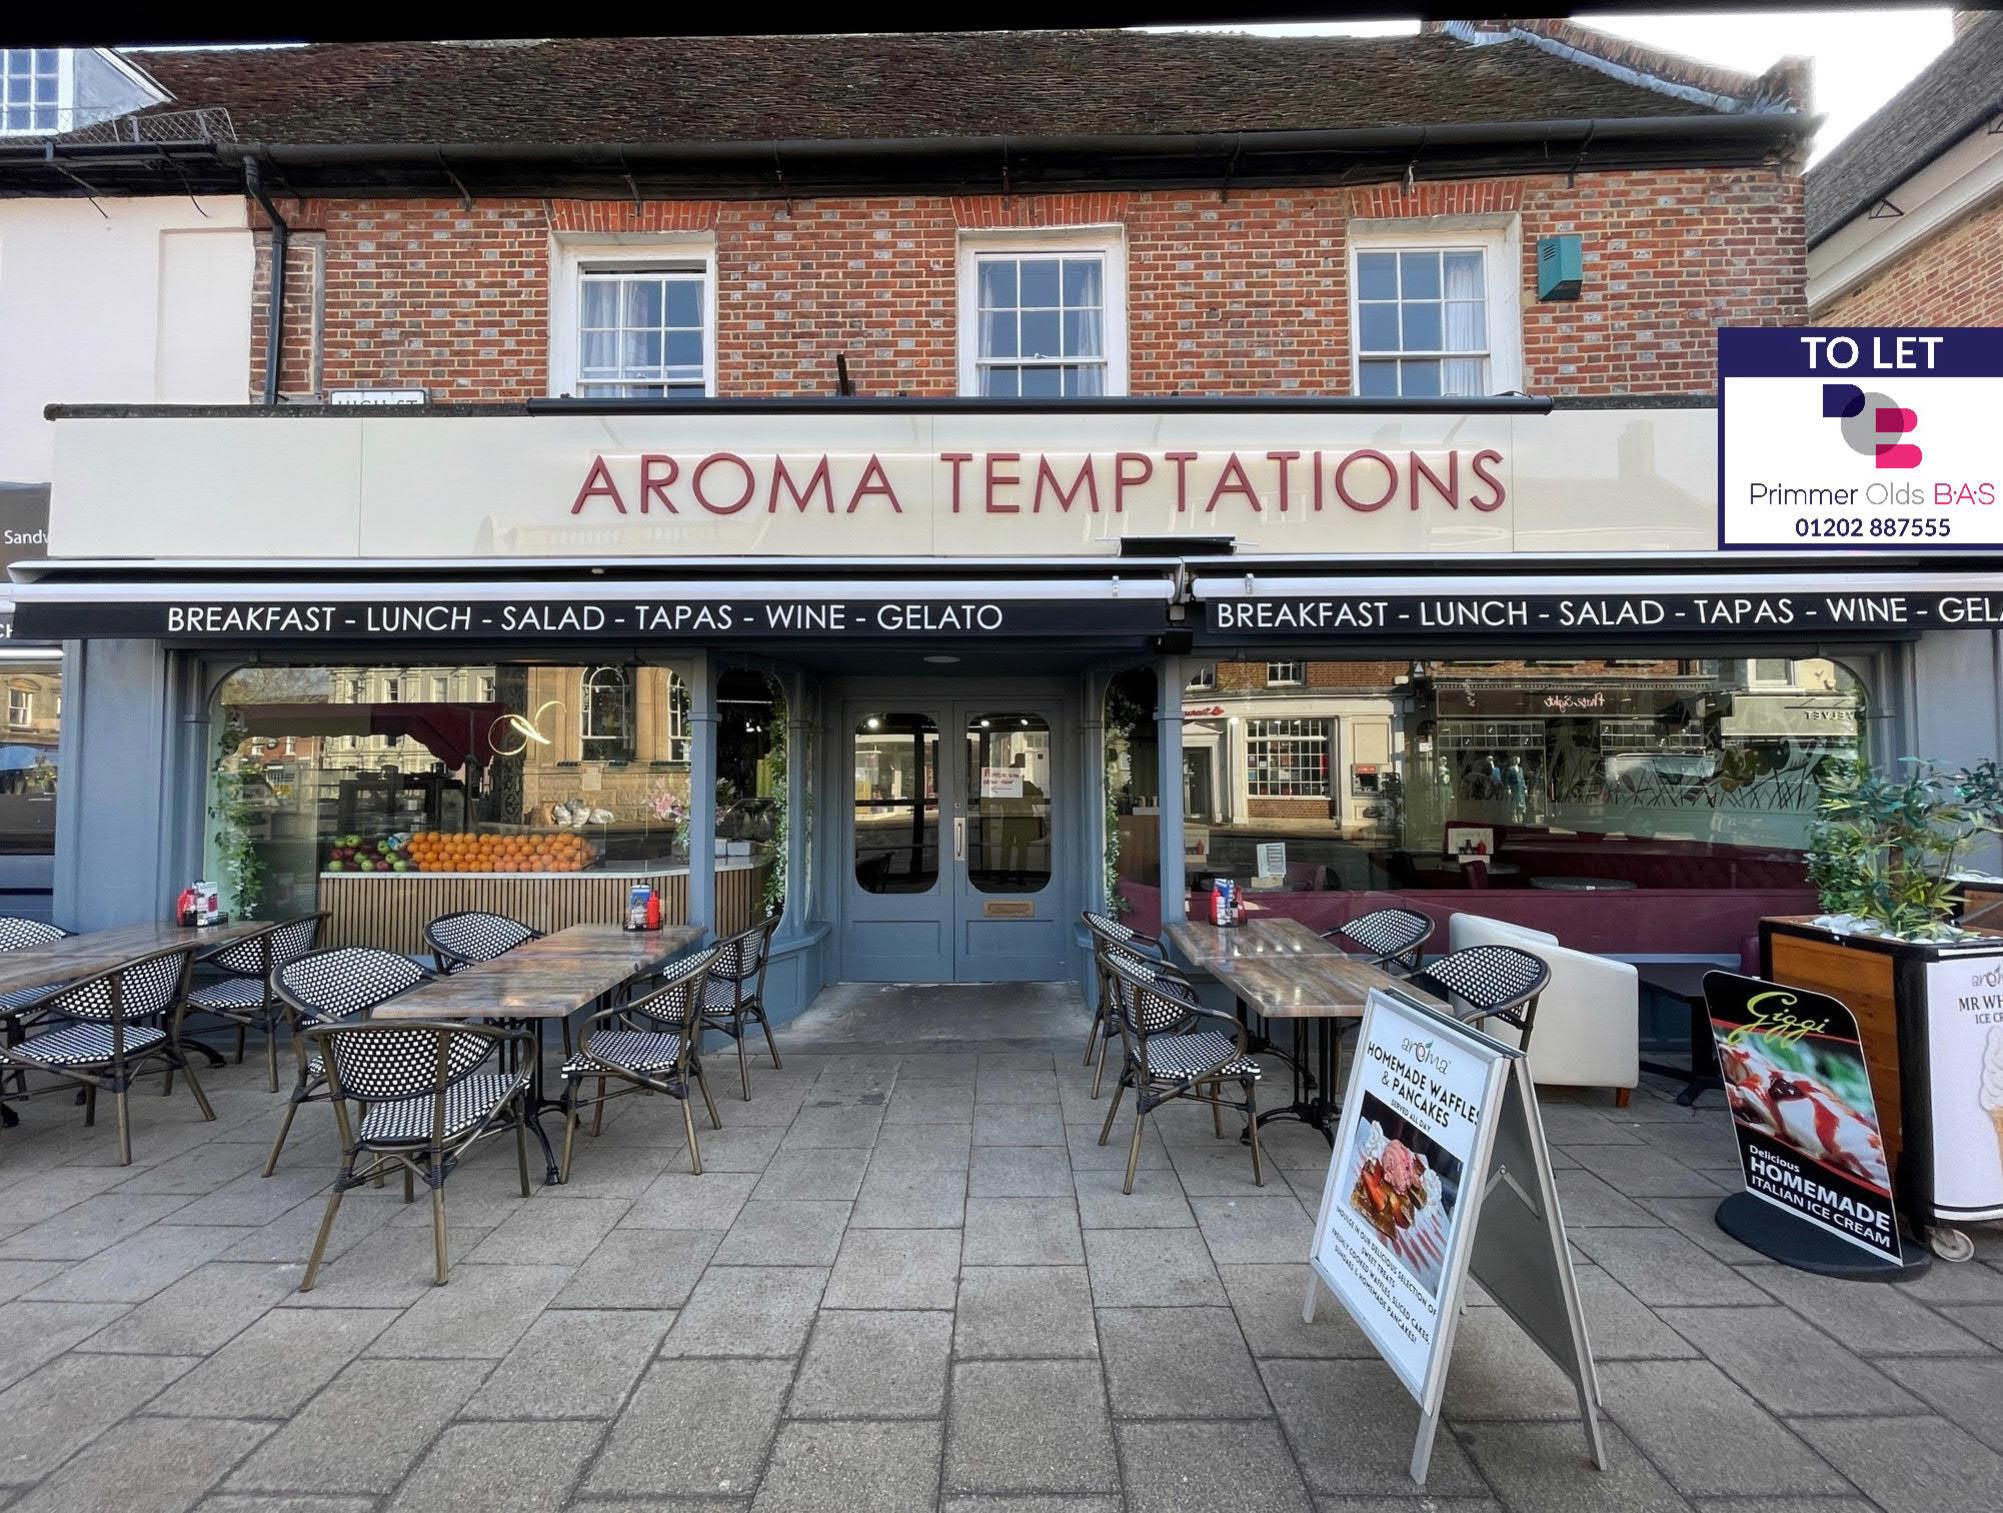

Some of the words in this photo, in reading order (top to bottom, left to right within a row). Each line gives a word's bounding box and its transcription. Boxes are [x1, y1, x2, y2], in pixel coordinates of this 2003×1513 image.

[570, 452, 903, 515] AROMA
[940, 448, 1506, 514] TEMPTATIONS
[168, 606, 336, 632] BREAKFAST
[367, 605, 471, 632] LUNCH
[500, 605, 605, 631] SALAD
[634, 604, 733, 630] TAPAS
[765, 604, 846, 630] WINE
[876, 604, 1003, 630] GELATO
[1217, 601, 1389, 628] BREAKFAST
[1421, 600, 1528, 627] LUNCH
[1559, 599, 1665, 626] SALAD
[1694, 598, 1794, 624] TAPAS
[1826, 597, 1908, 622] WINE
[1938, 596, 2003, 623] GEL
[1958, 996, 1980, 1012] MR
[1975, 1013, 1991, 1024] ICE
[1367, 1041, 1427, 1090] HOMEMADE
[1382, 1070, 1389, 1087] &
[1392, 1078, 1450, 1128] PANCAKES
[1420, 1120, 1431, 1133] DAY
[1749, 1144, 1800, 1173] Delicious
[1751, 1156, 1890, 1232] HOMEMADE
[1752, 1175, 1804, 1207] ITALIAN
[1807, 1200, 1830, 1220] ICE
[1833, 1213, 1890, 1248] CREAM
[1349, 1247, 1369, 1273] COOKED
[1392, 1296, 1410, 1320] SLICED
[1360, 1231, 1370, 1246] OUR
[1371, 1243, 1397, 1274] DELICIOUS
[1398, 1271, 1427, 1307] SELECTION
[1428, 1304, 1437, 1317] OF
[1362, 1246, 1377, 1267] SWEET
[1377, 1264, 1395, 1287] TREATS
[1359, 1272, 1386, 1309] HOMEMADE
